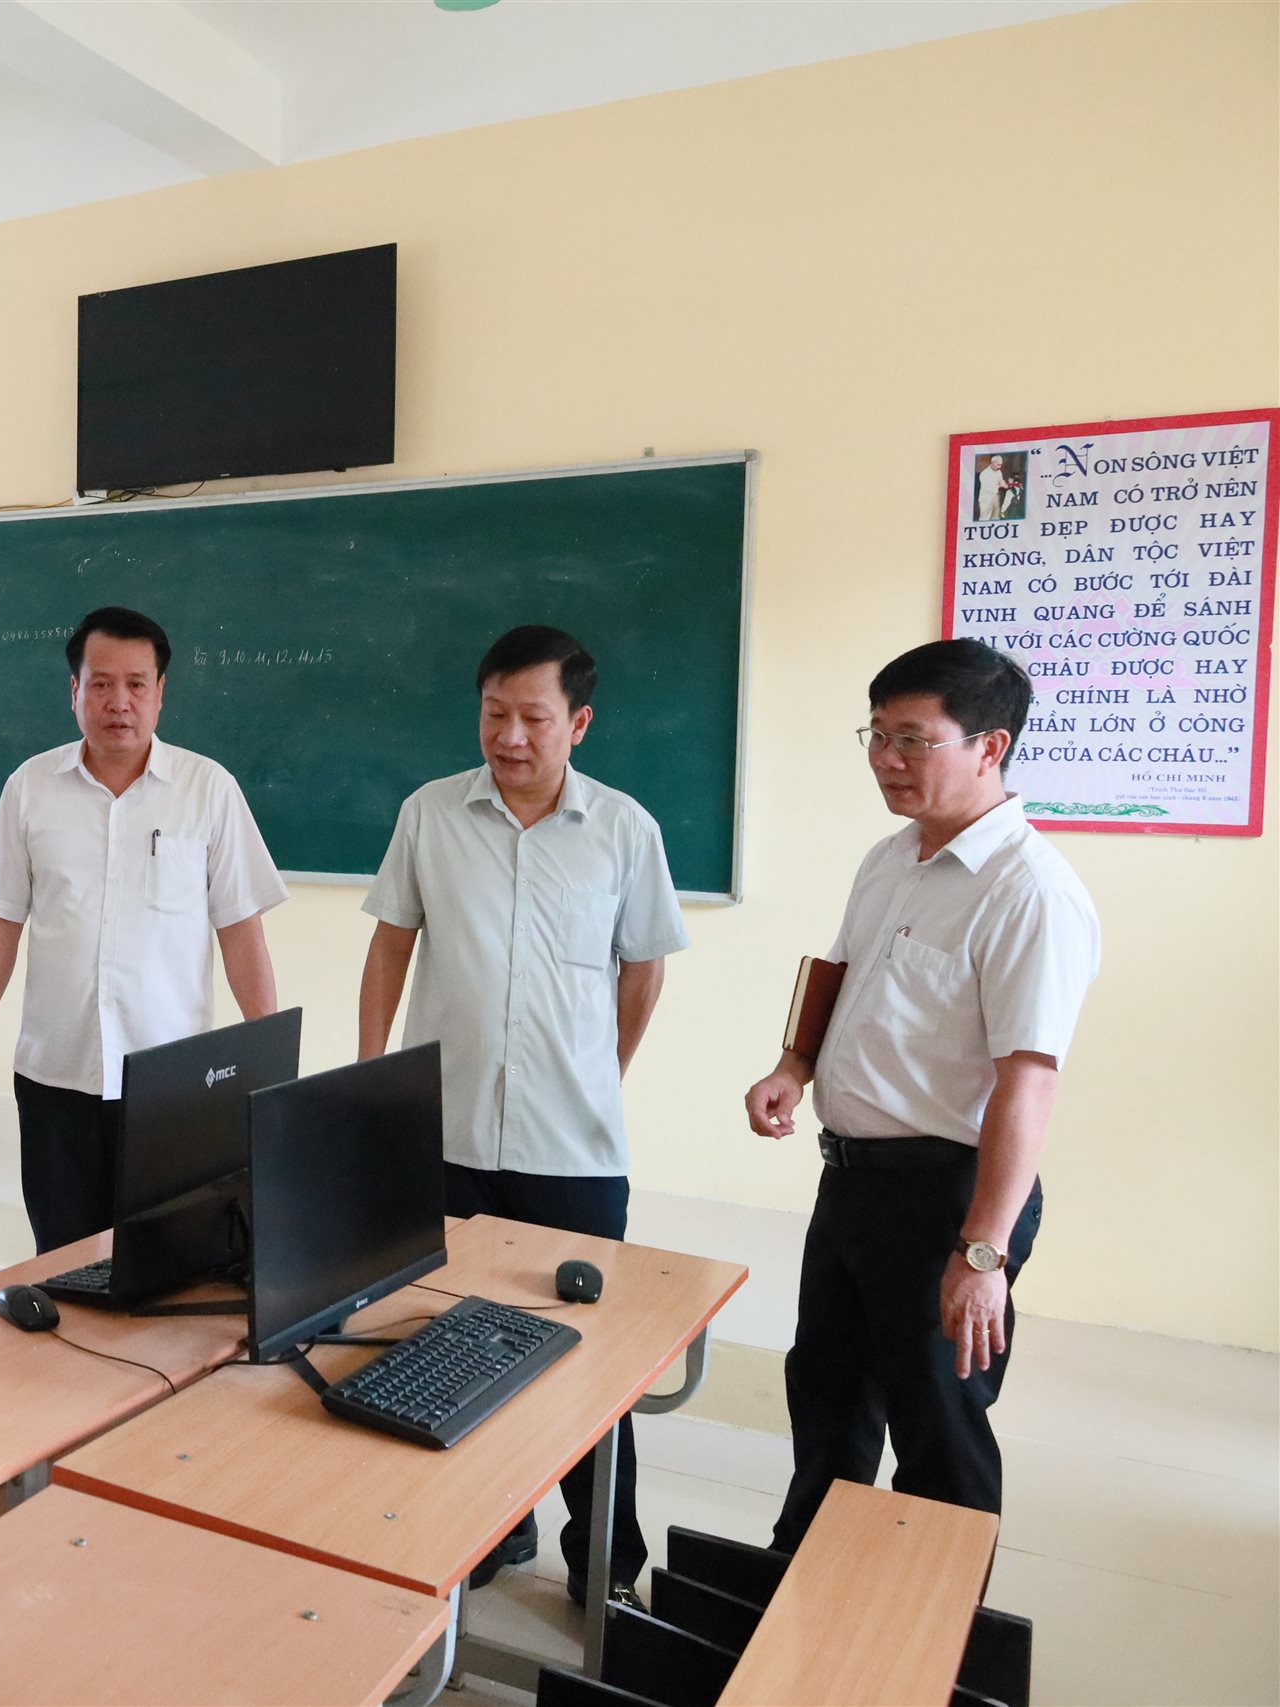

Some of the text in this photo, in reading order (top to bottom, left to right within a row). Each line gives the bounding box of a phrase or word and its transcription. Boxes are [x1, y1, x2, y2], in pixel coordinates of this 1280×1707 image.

[1131, 451, 1197, 472] SÔNG
[1201, 445, 1260, 470] VIỆT
[1046, 477, 1258, 509] NAM CÓ TRỞ NÊN
[964, 510, 1257, 541] TƯƠI ĐẸP ĐƯỢC HAY
[963, 537, 1256, 568] KHÔNG, DÂN TỘC VIỆT
[962, 566, 1253, 596] NAM CÓ BƯỚC TỚI ĐÀI
[961, 592, 1252, 623] VINH QUANG ĐỂ SÁNH
[1004, 631, 1043, 649] VỚI
[1048, 629, 1093, 649] CÁC
[1097, 627, 1178, 647] CƯỜNG
[1183, 622, 1251, 647] QUỐC
[1027, 657, 1248, 679] CHÂU ĐƯỢC HAY
[1056, 685, 1130, 704] CHÍNH
[1146, 685, 1177, 704] LÀ
[1193, 683, 1247, 704] NHỜ
[1089, 713, 1136, 732] LỚN
[1148, 710, 1167, 733] Ở
[1178, 713, 1246, 733] CÔNG
[1048, 740, 1094, 762] CỦA
[1098, 743, 1143, 762] CÁC
[1156, 772, 1182, 782] CHÍ
[1186, 774, 1226, 783] MINH
